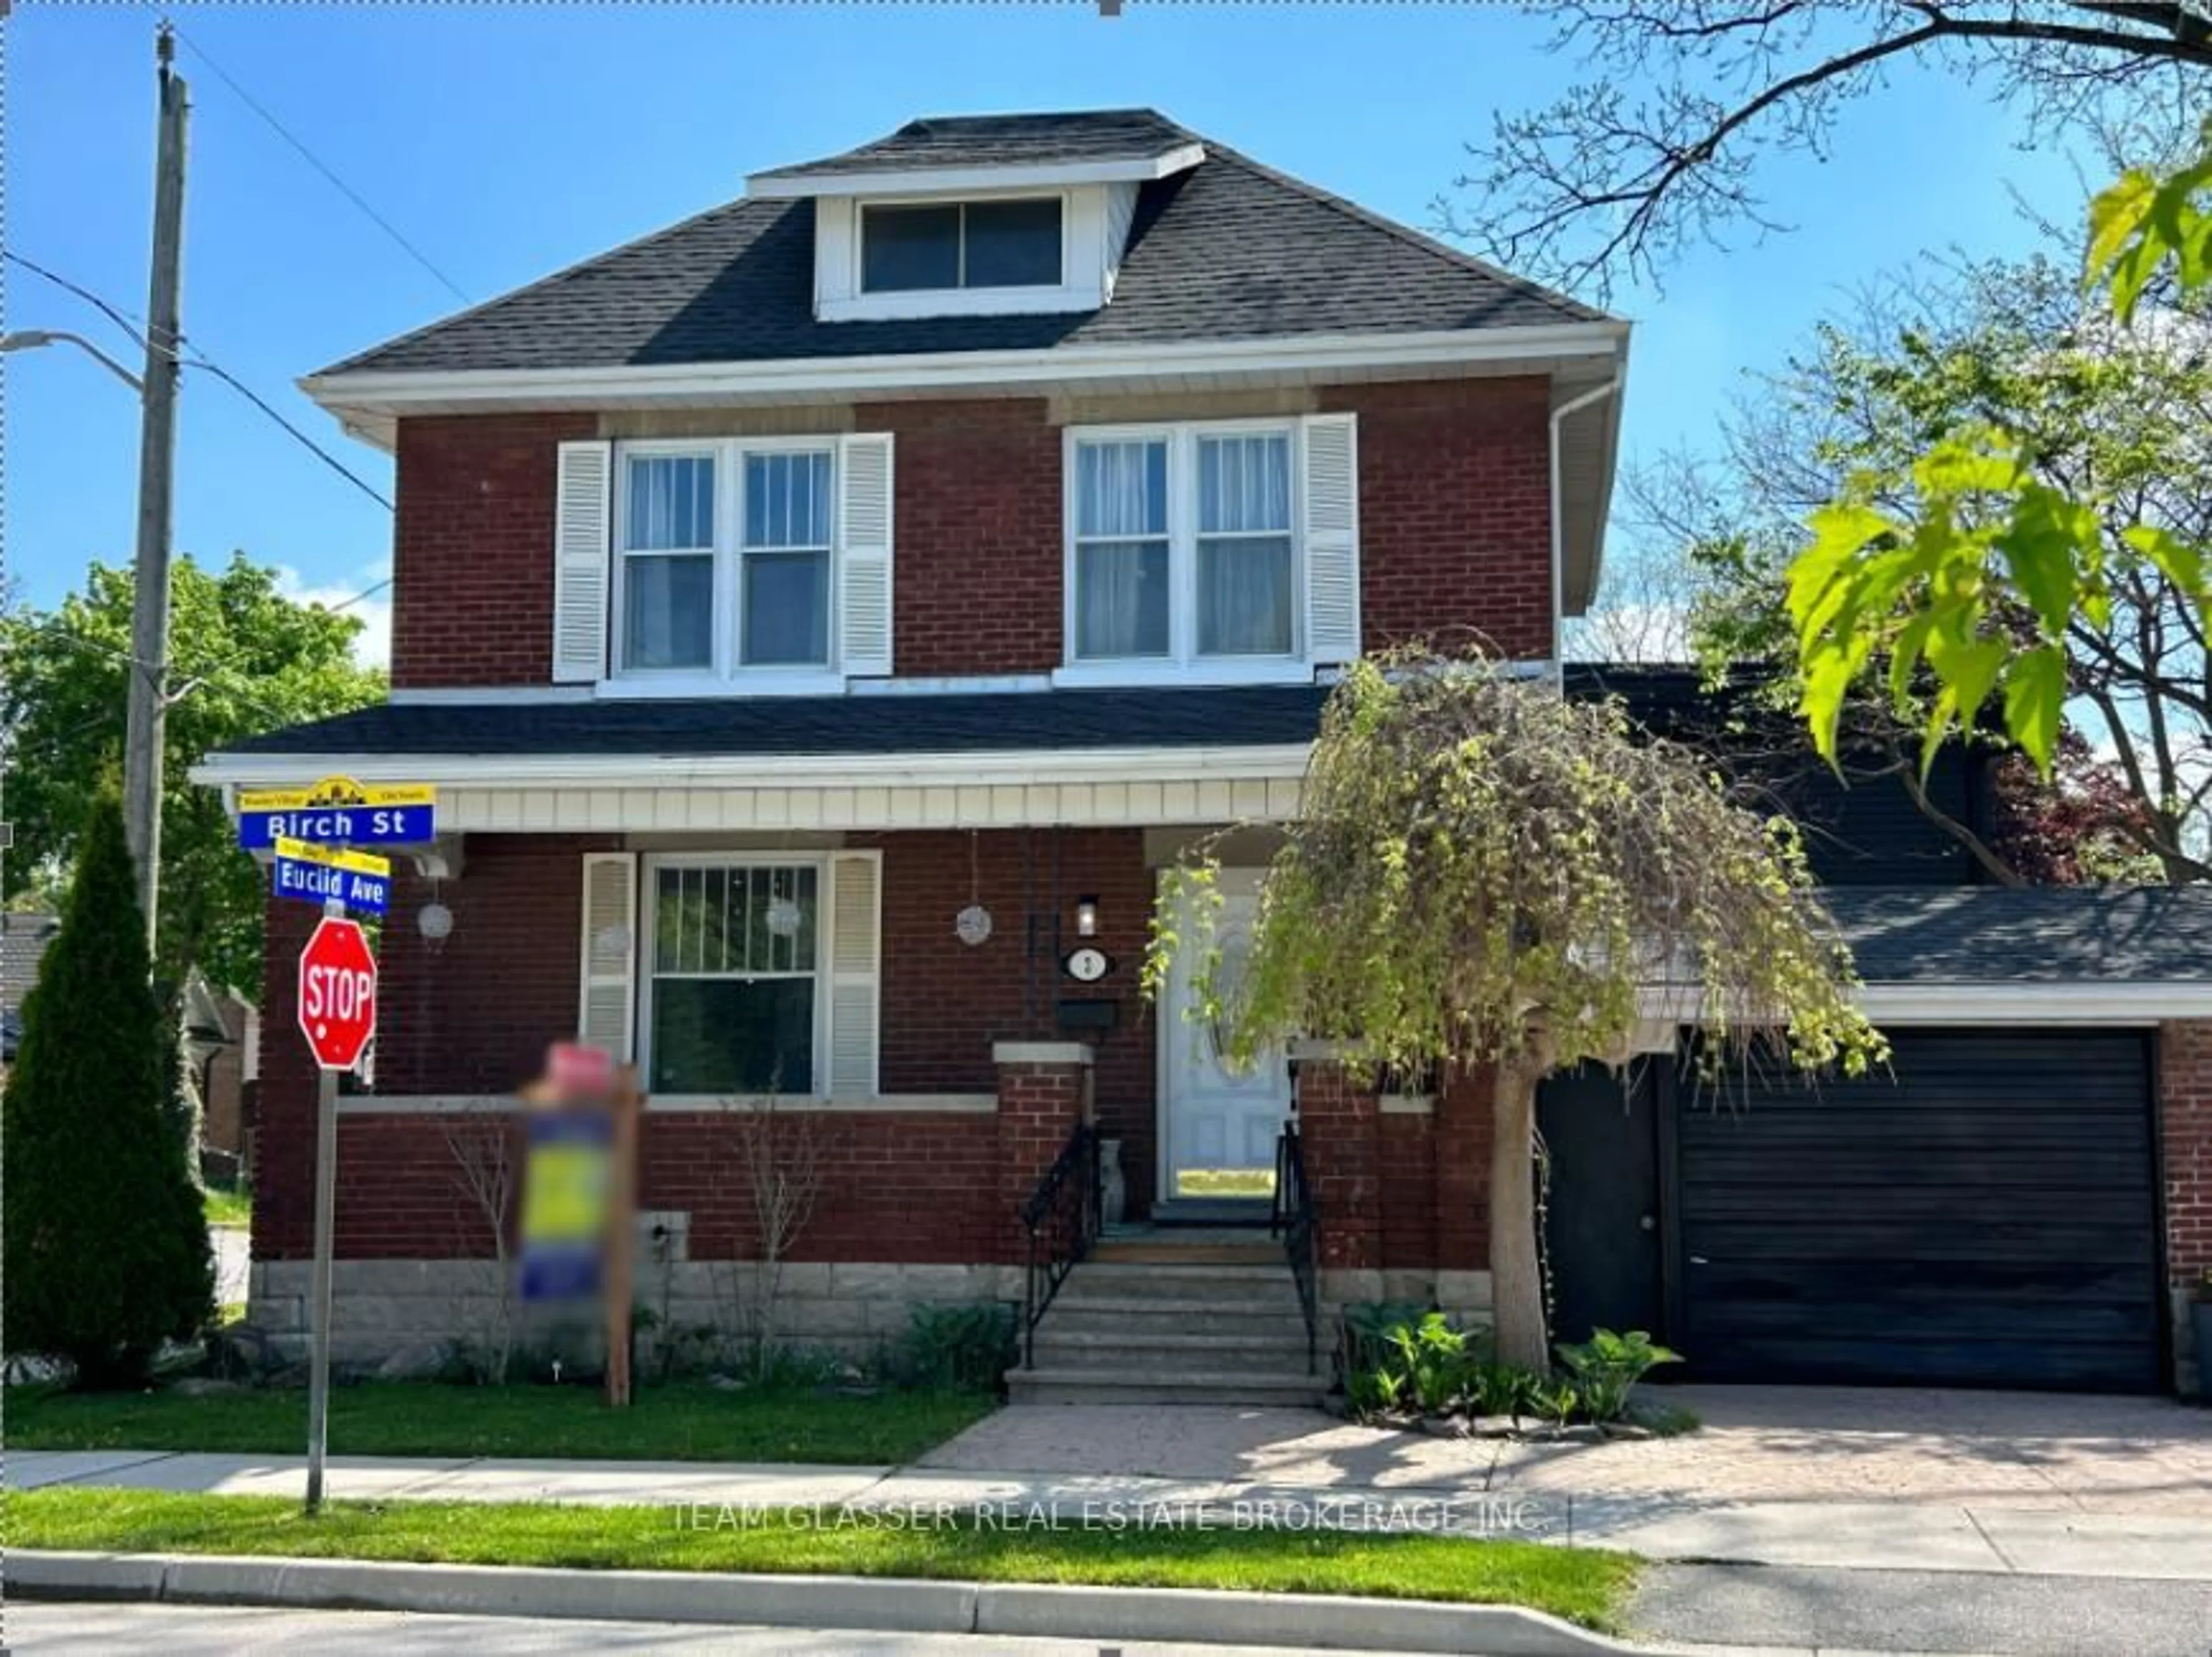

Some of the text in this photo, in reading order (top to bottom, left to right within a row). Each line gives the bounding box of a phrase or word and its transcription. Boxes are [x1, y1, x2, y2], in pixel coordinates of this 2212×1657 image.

[267, 810, 407, 838] Birch St
[281, 862, 343, 896] Euclid
[351, 874, 384, 904] Ave
[307, 965, 370, 1022] STOP
